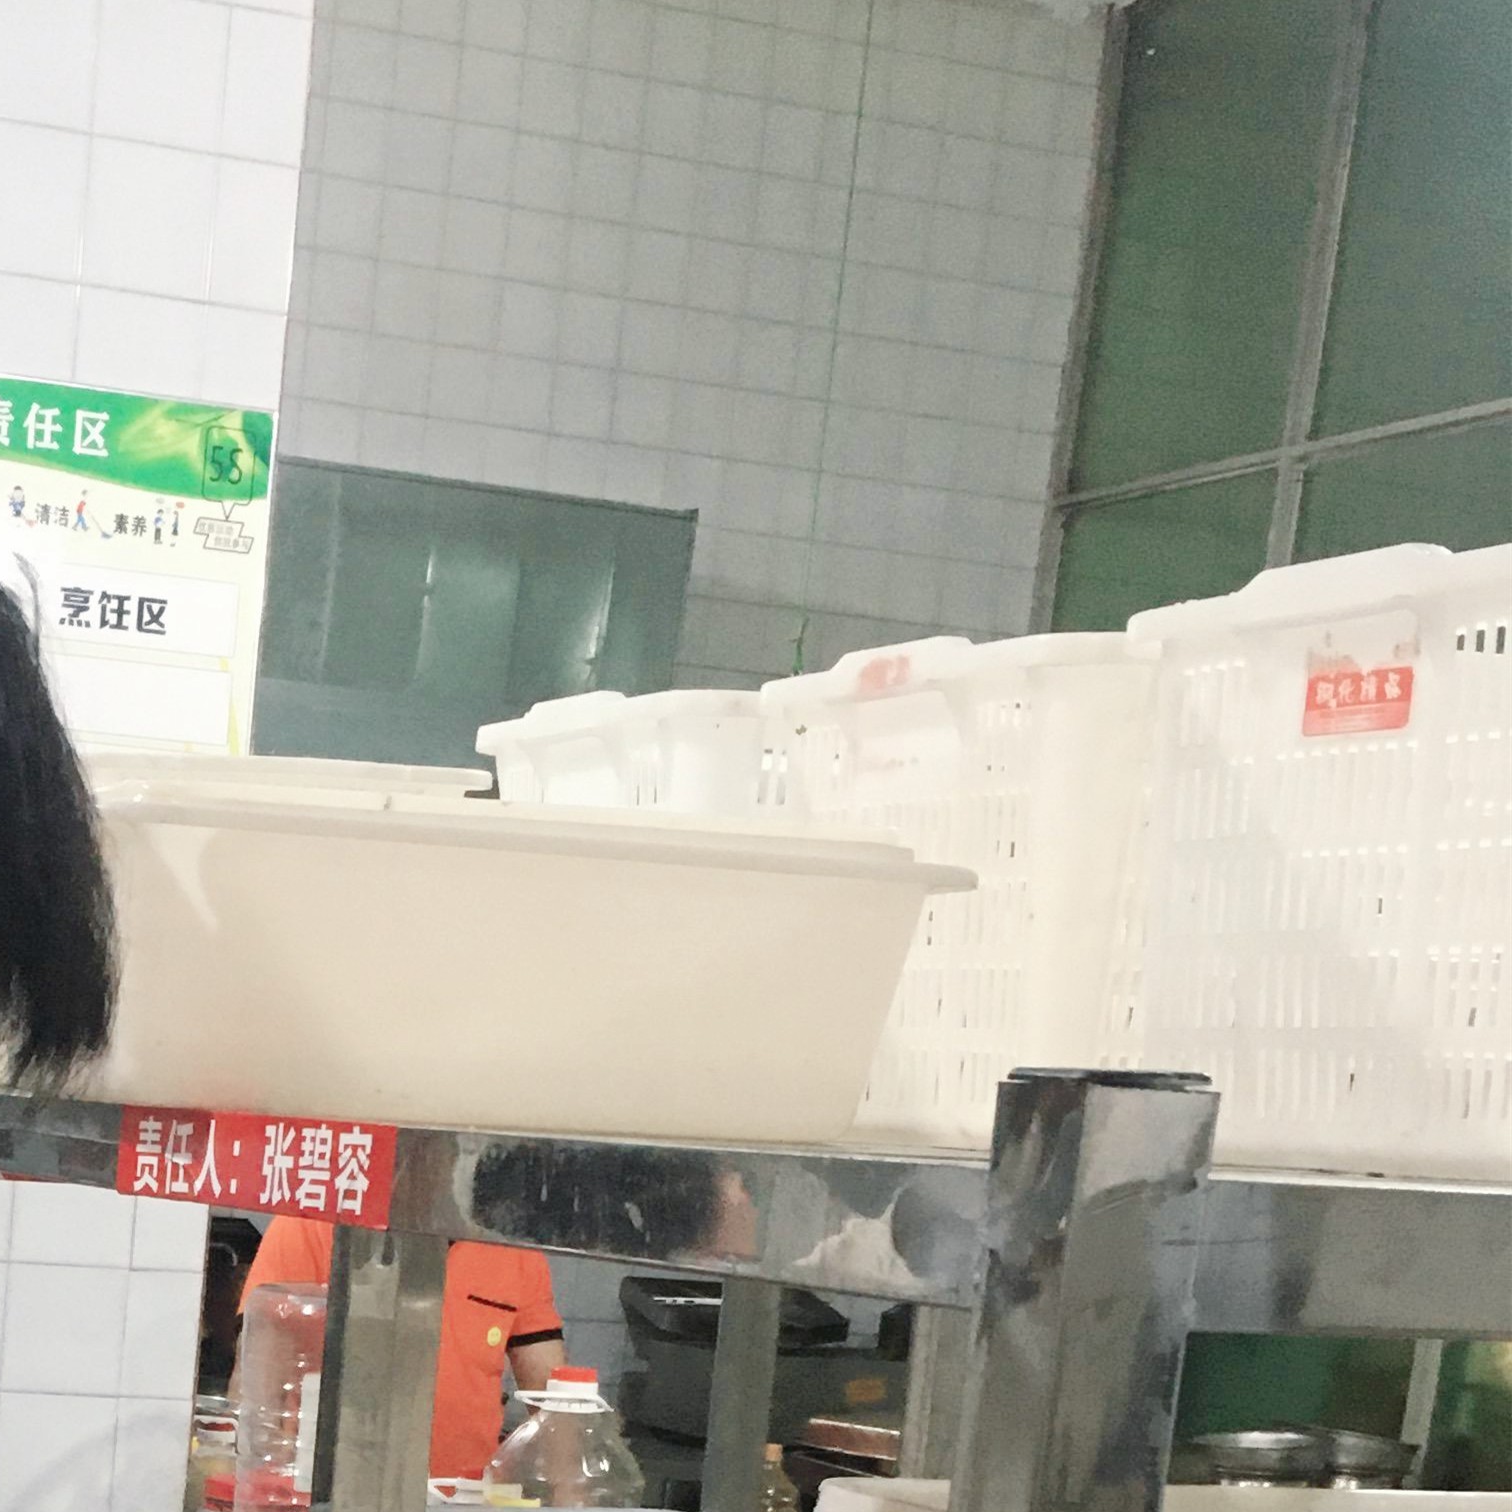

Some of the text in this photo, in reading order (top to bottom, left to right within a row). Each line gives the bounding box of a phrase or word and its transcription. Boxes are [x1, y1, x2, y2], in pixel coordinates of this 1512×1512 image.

[209, 446, 243, 485] 5S
[35, 502, 69, 528] 清洁
[113, 513, 147, 537] 素养
[59, 587, 168, 635] 烹饪区
